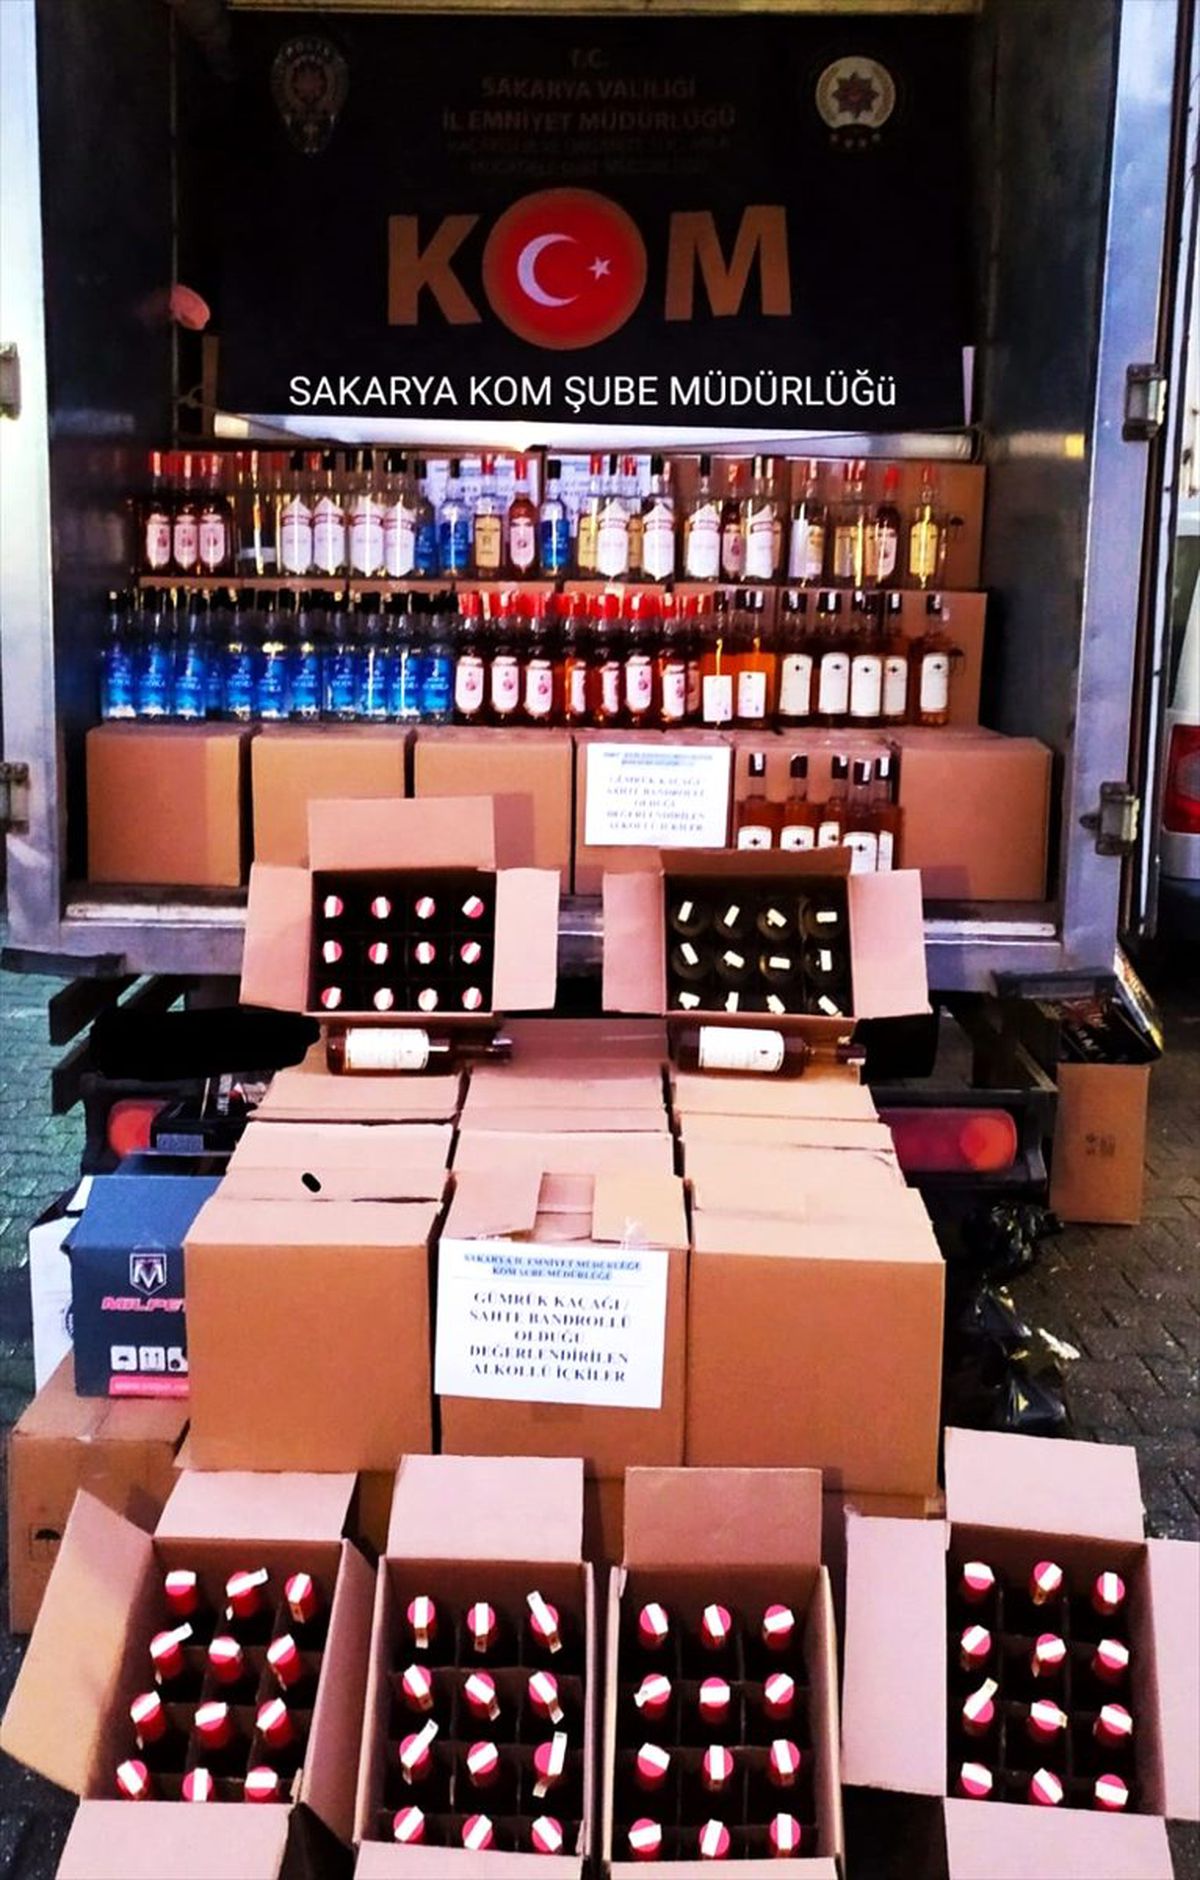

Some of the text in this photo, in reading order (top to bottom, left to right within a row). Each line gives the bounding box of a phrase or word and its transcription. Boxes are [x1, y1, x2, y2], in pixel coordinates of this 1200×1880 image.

[480, 75, 592, 101] SAKARYA
[468, 106, 576, 132] EMNİYET
[578, 101, 737, 130] MÜDÜRLÜĞÜ
[473, 1290, 547, 1307] GÜMRÜK
[469, 1309, 632, 1329] SAHTE BANDROLLÜ
[513, 1328, 583, 1344] OLDUĞU
[469, 1344, 629, 1364] DEĞERLENDİRİLEN
[472, 1363, 626, 1383] ALKOLLÜ İÇKİLER
